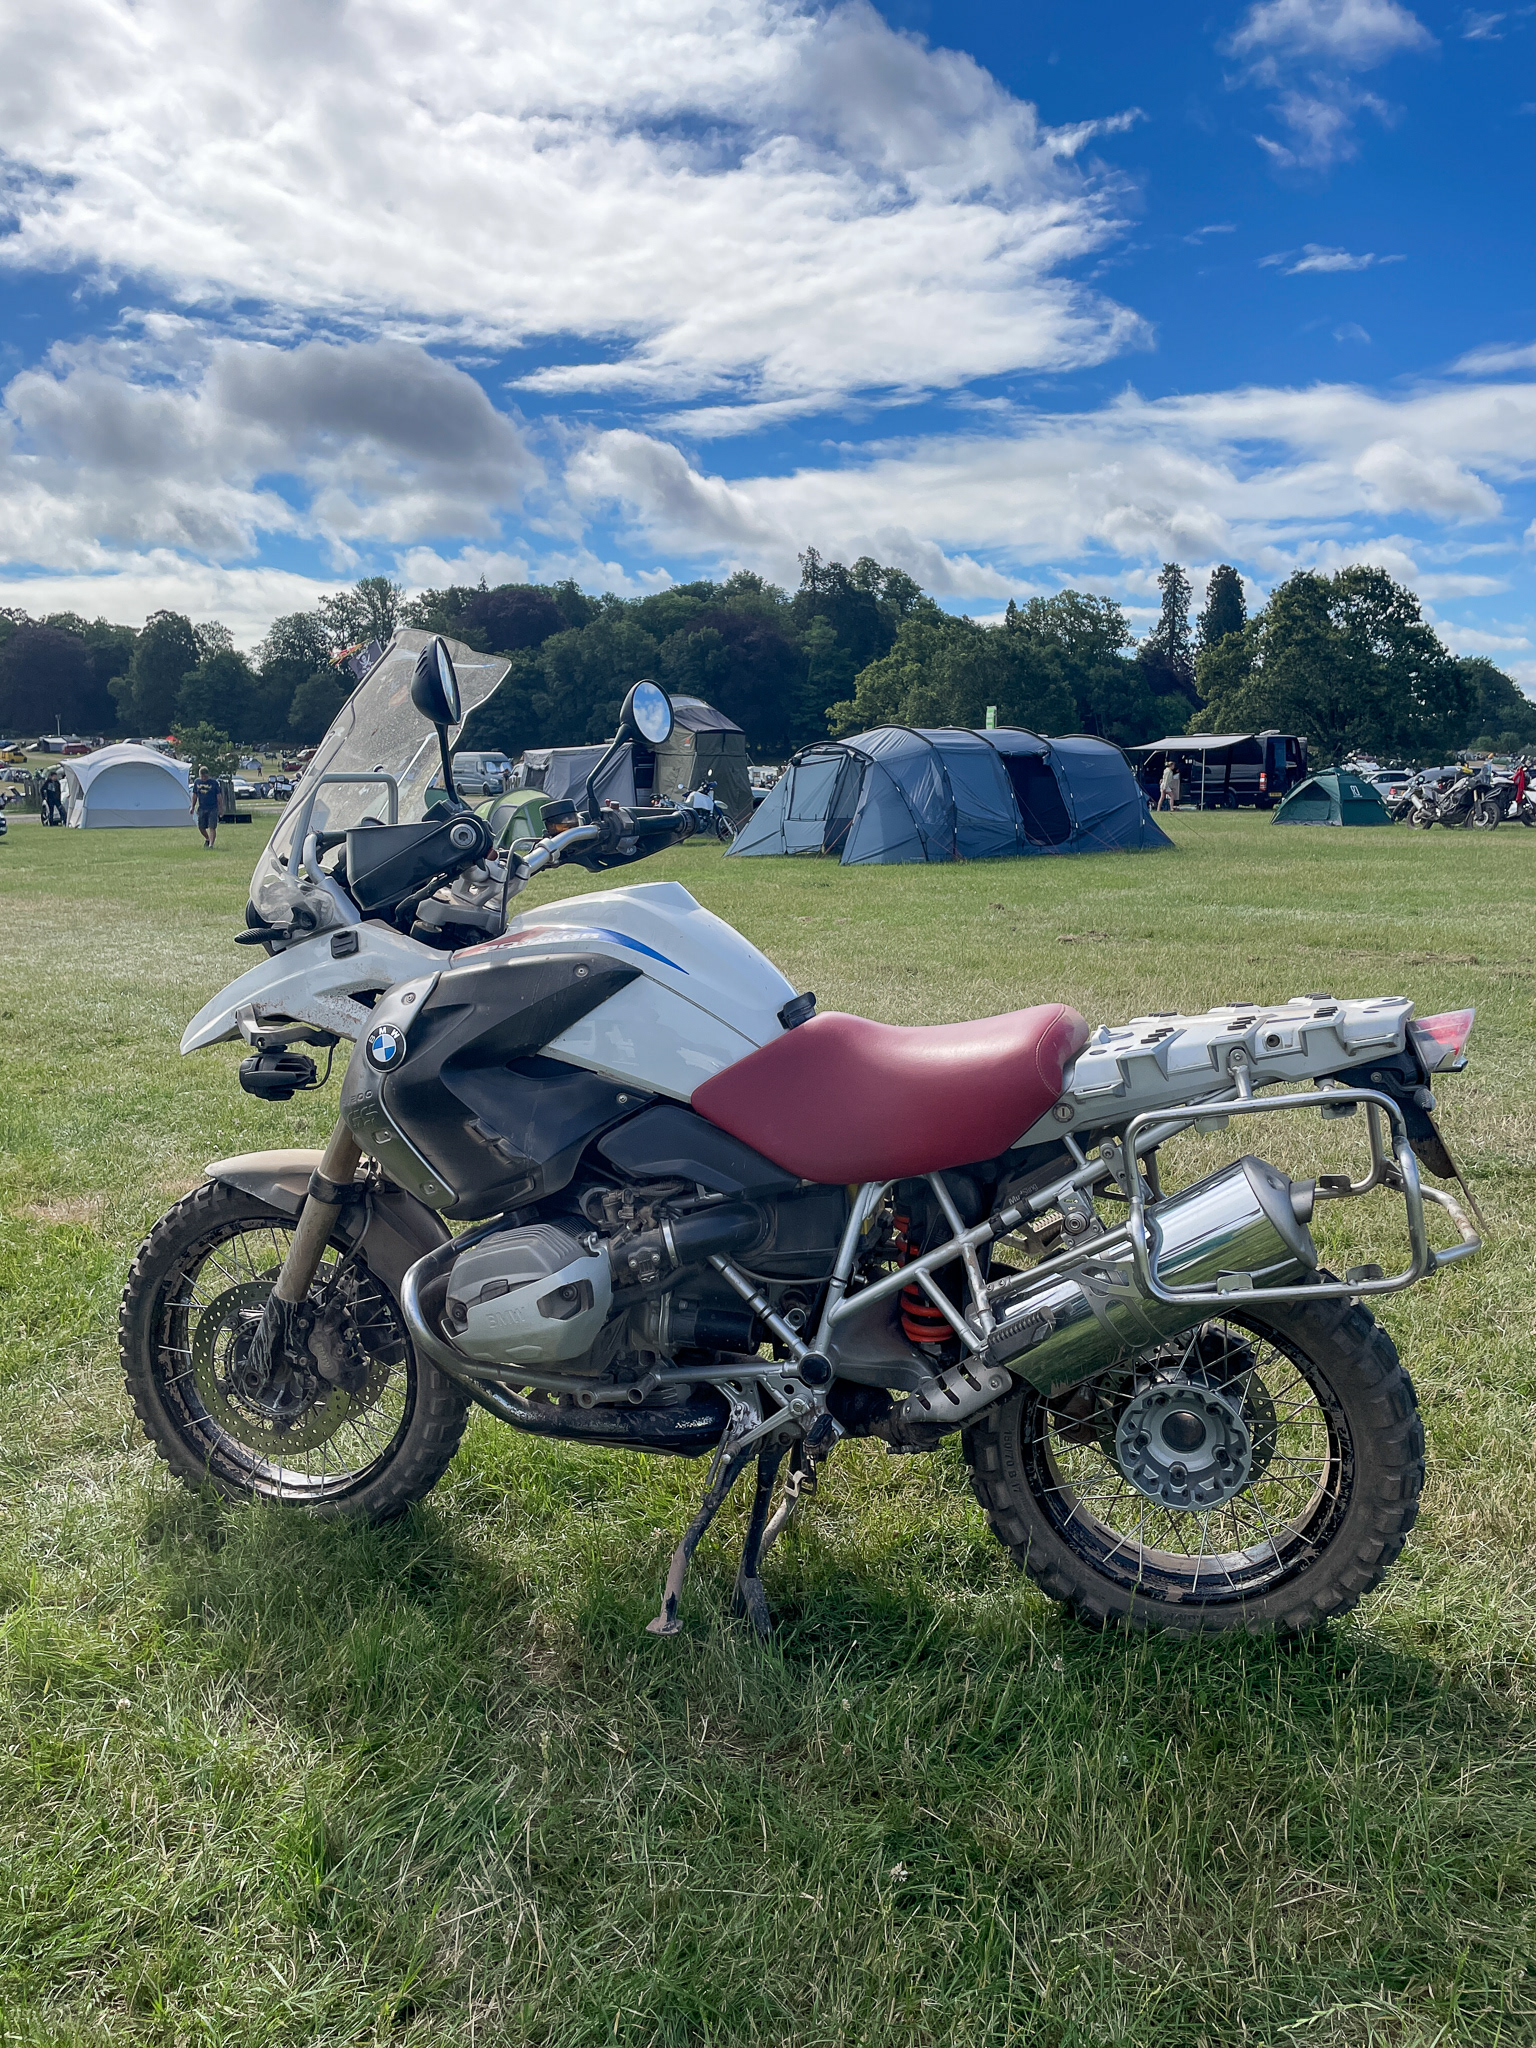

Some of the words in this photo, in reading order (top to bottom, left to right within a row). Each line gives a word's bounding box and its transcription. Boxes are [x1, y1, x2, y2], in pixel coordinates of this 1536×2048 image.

[368, 1026, 400, 1044] BMW
[1008, 1183, 1039, 1206] MuSling
[485, 1306, 526, 1329] BMW
